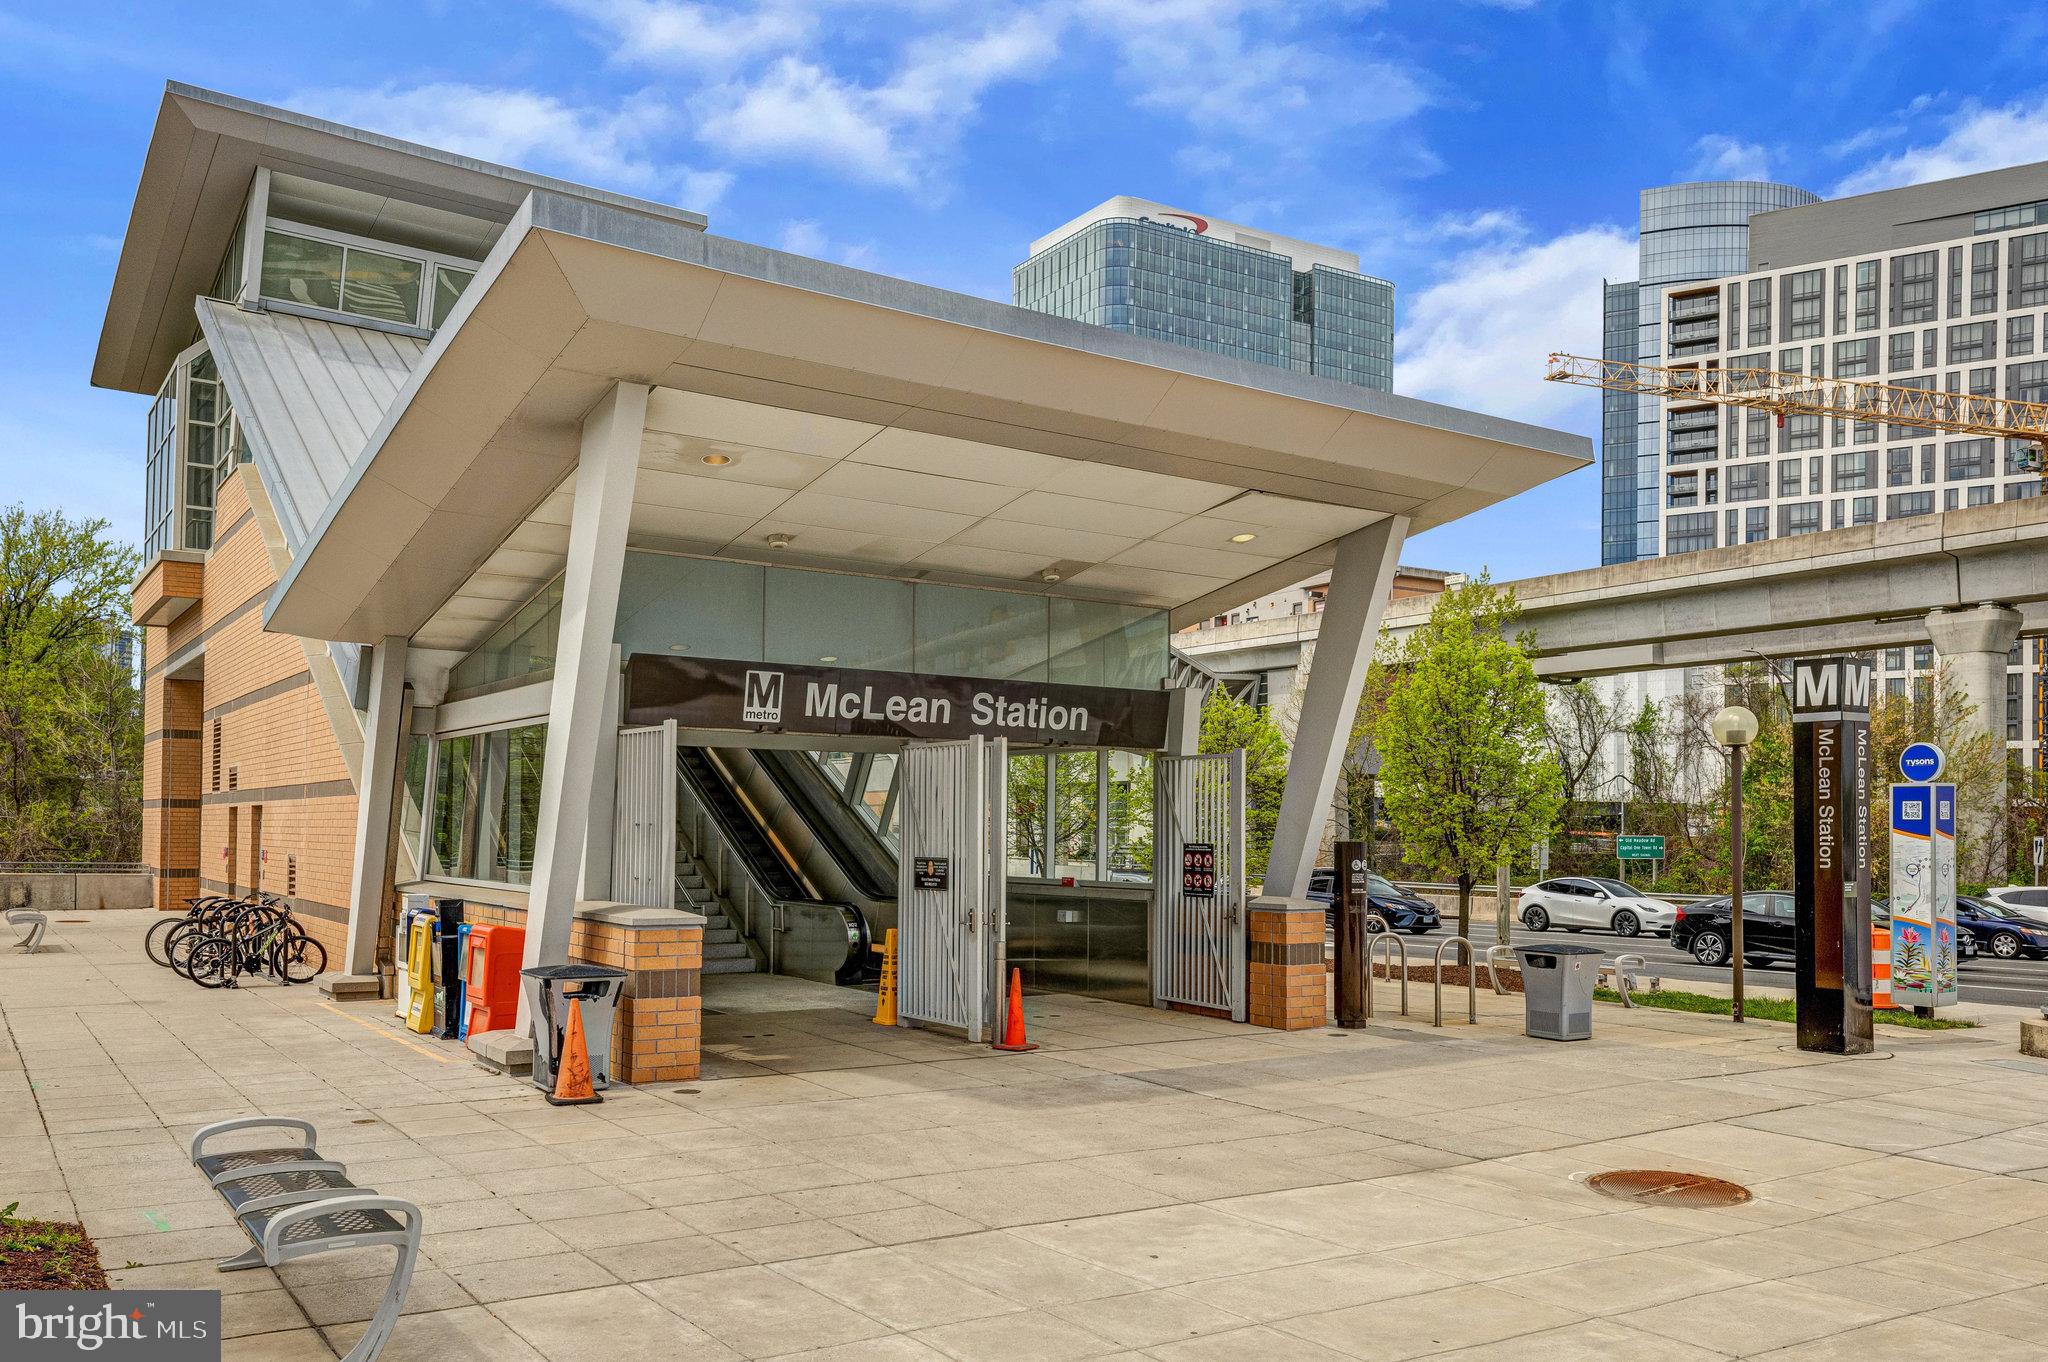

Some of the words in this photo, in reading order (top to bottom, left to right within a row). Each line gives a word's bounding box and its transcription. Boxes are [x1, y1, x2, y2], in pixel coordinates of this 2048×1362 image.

[804, 682, 951, 724] McLean
[970, 692, 1089, 731] Station
[1796, 664, 1838, 707] M
[1844, 664, 1870, 707] M
[745, 710, 779, 721] metro
[1818, 728, 1834, 800] McLean
[1857, 729, 1867, 800] McLean
[1818, 805, 1835, 869] Station
[1858, 805, 1867, 869] Station
